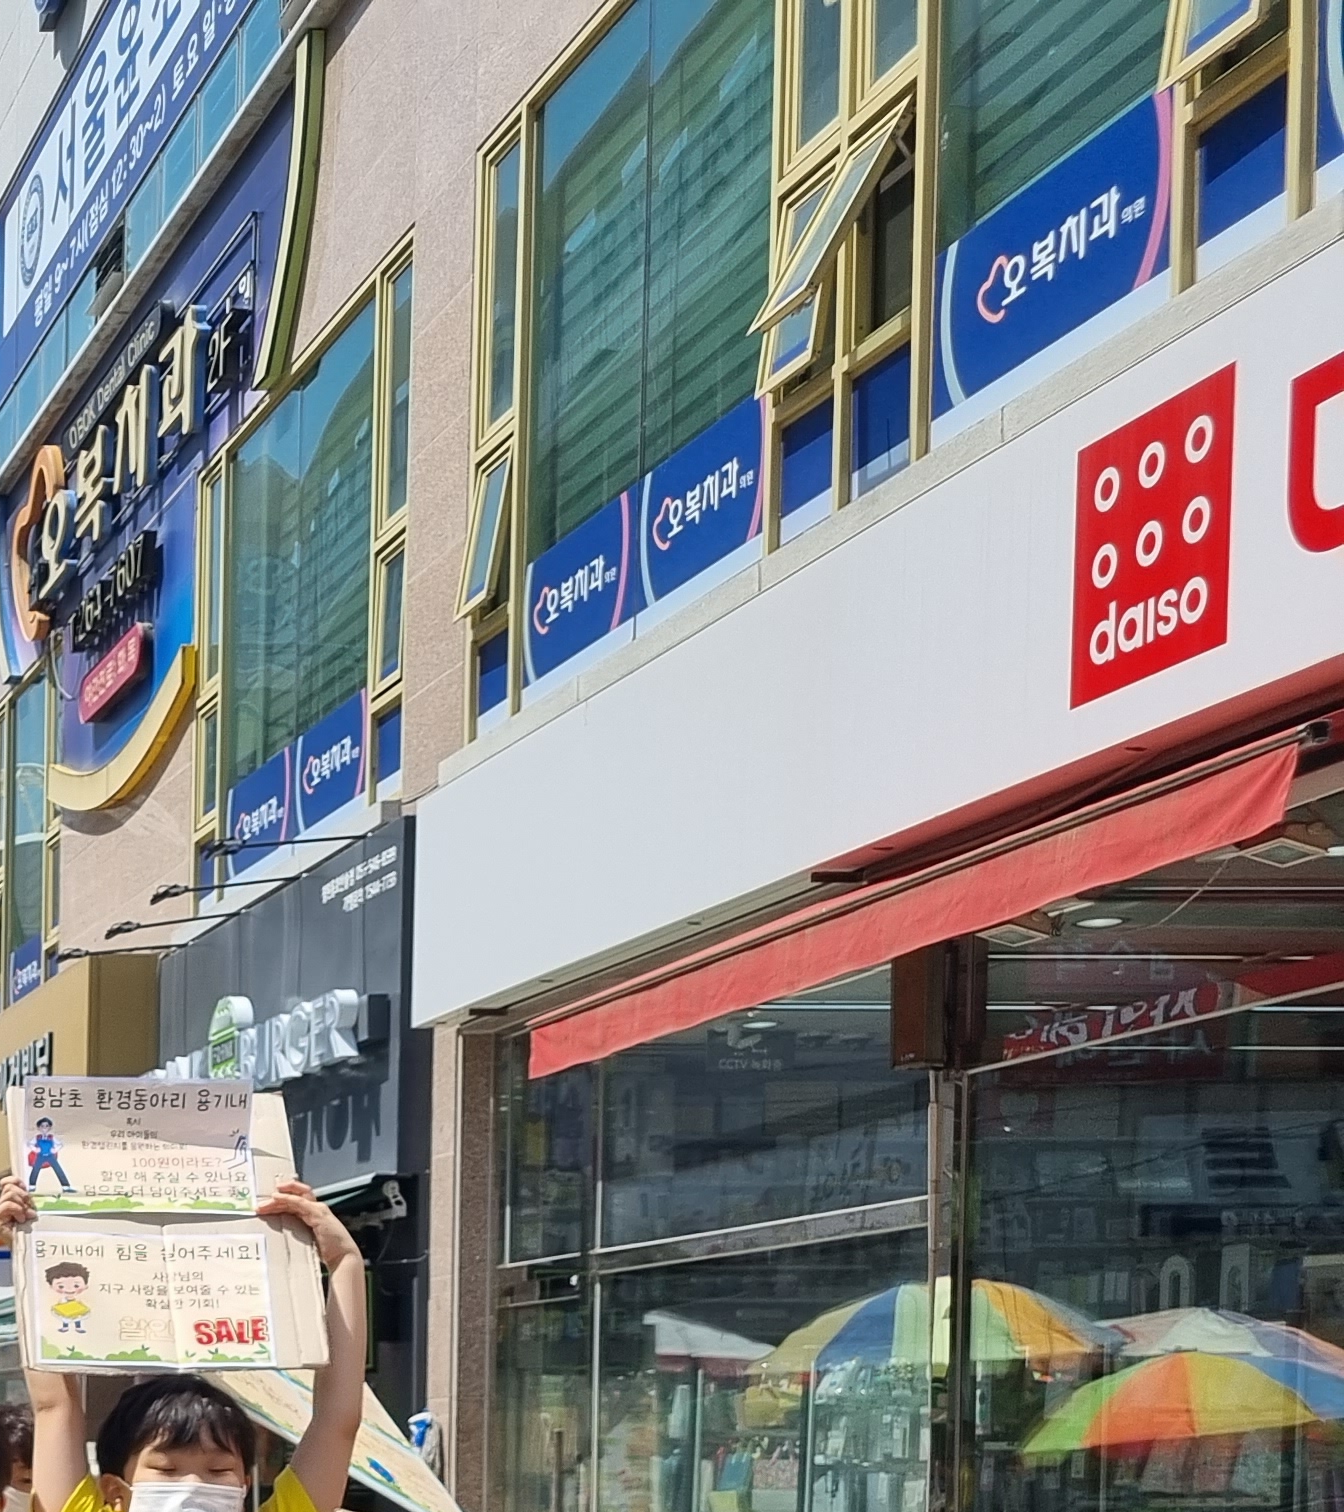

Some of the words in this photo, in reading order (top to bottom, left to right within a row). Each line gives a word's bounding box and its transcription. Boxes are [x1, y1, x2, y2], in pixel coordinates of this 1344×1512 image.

[1002, 184, 1121, 307] 오복치과
[1120, 195, 1147, 226] 의원
[97, 356, 126, 409] Dental
[127, 320, 156, 367] Clinic
[668, 456, 741, 539] 오복치과
[1088, 575, 1210, 665] daiso
[718, 1059, 749, 1071] CCTV
[32, 1087, 84, 1110] 용남초
[96, 1089, 186, 1111] 환경동아리
[34, 1240, 105, 1259] 용기내에
[116, 1243, 149, 1261] 힘을
[161, 1242, 261, 1262] 실어주세요!
[193, 1316, 269, 1345] SALE
